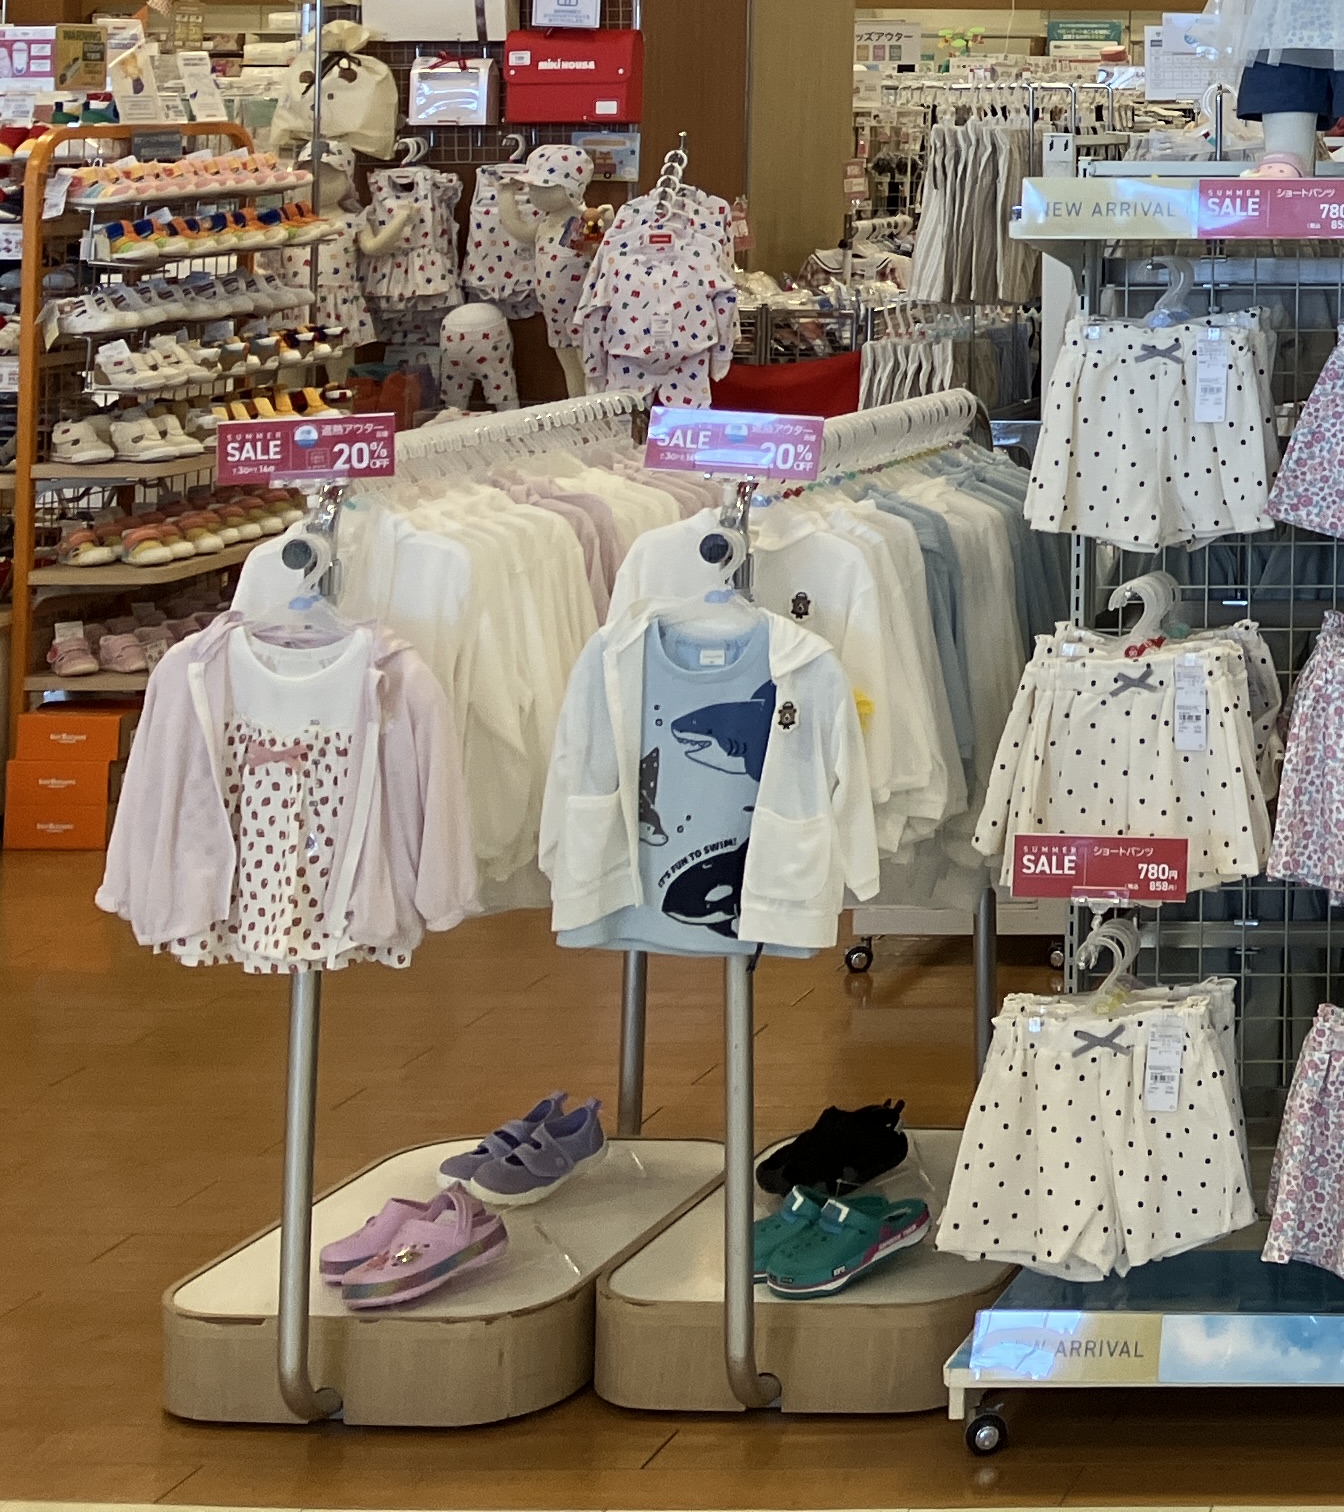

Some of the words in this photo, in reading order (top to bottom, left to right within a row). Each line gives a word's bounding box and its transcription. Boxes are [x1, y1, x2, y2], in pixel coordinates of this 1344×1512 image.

[1207, 188, 1261, 197] SUMMER
[1276, 187, 1335, 199] ショートパンツ
[1092, 201, 1176, 218] ARRIVAL
[1206, 197, 1260, 217] SALE
[657, 428, 712, 449] SALE
[227, 440, 282, 463] SALE
[333, 441, 388, 470] 20%
[369, 458, 390, 469] OFF
[793, 461, 813, 472] OFF
[1023, 845, 1077, 854] SUMMER
[1093, 846, 1154, 857] ショートパンツ
[670, 856, 689, 874] FUN
[688, 849, 702, 862] TO
[1022, 855, 1077, 875] SALE
[1138, 863, 1178, 880] 780円
[1055, 1340, 1144, 1358] ARRIVAL
